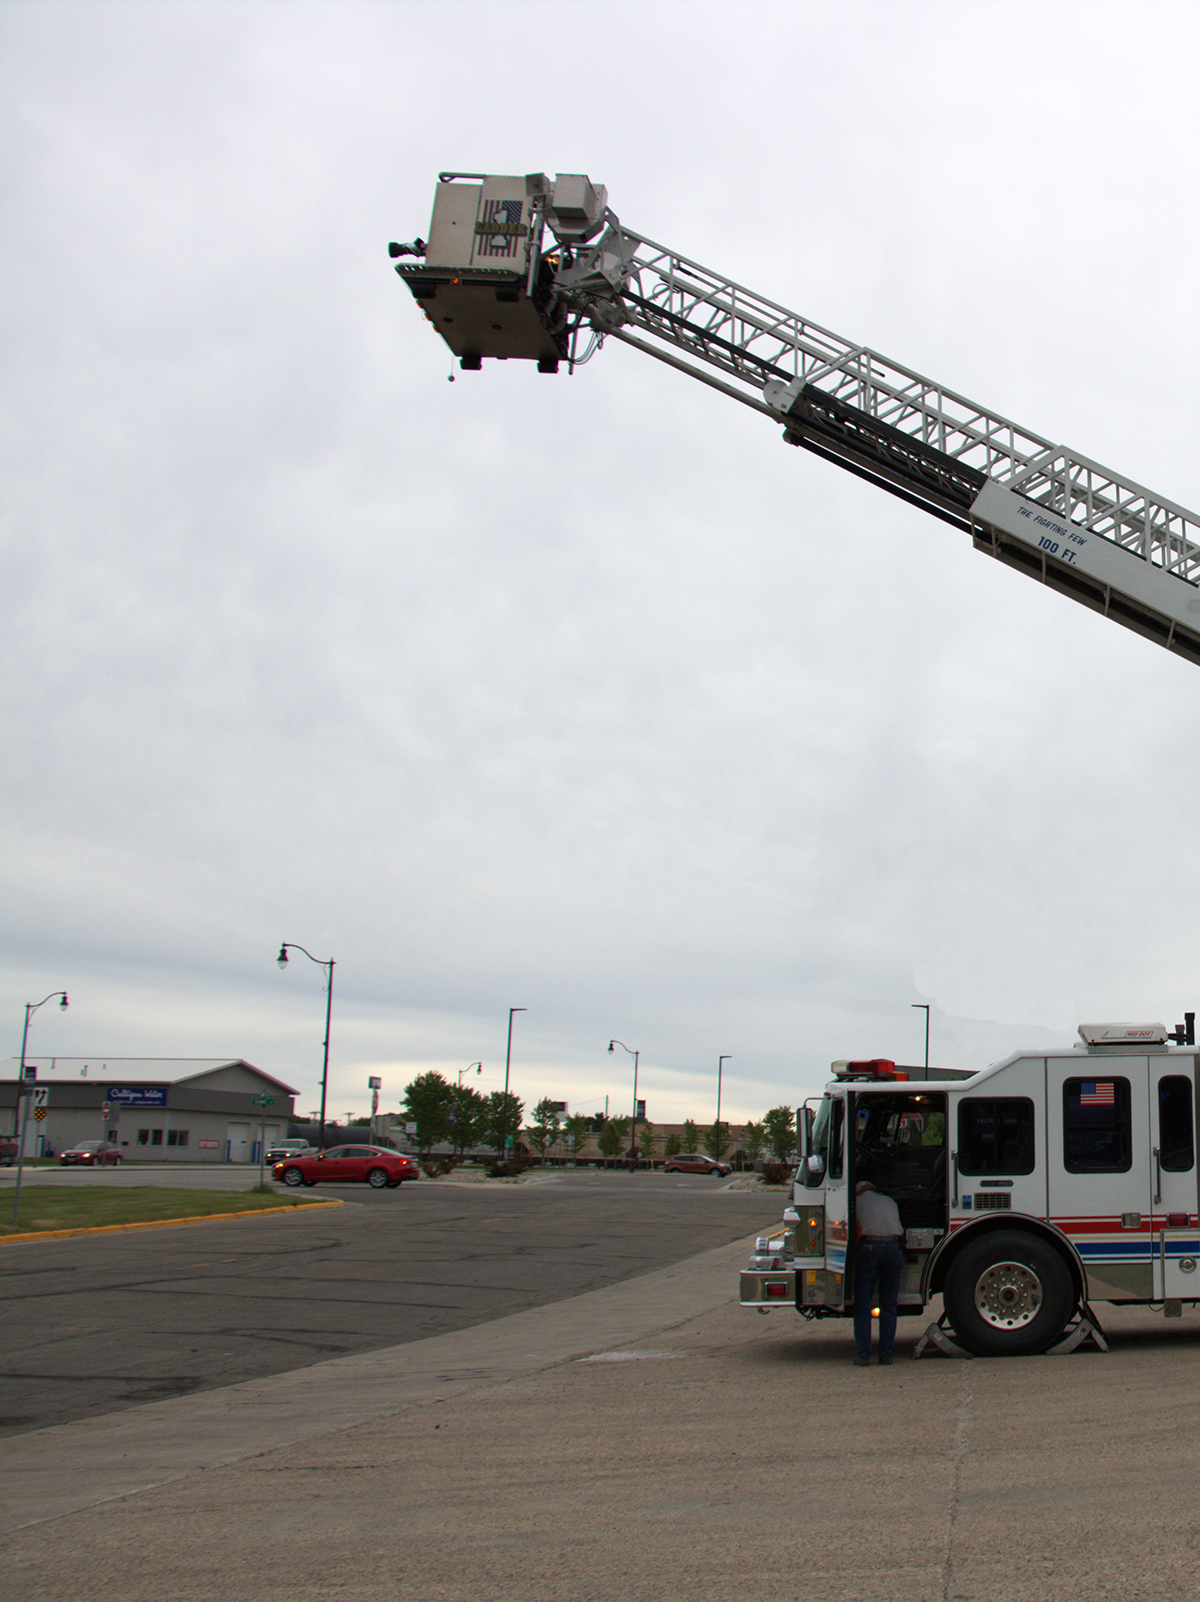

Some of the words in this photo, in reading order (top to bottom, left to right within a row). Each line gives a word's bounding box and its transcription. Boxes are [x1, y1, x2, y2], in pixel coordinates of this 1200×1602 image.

[475, 221, 527, 236] LADDER
[1017, 506, 1034, 518] THE
[1033, 515, 1068, 536] FIGHTING
[1068, 532, 1087, 546] FEW
[1038, 536, 1059, 553] 100
[1061, 548, 1076, 565] FT.
[110, 1088, 143, 1101] Culligan
[143, 1089, 163, 1098] Water
